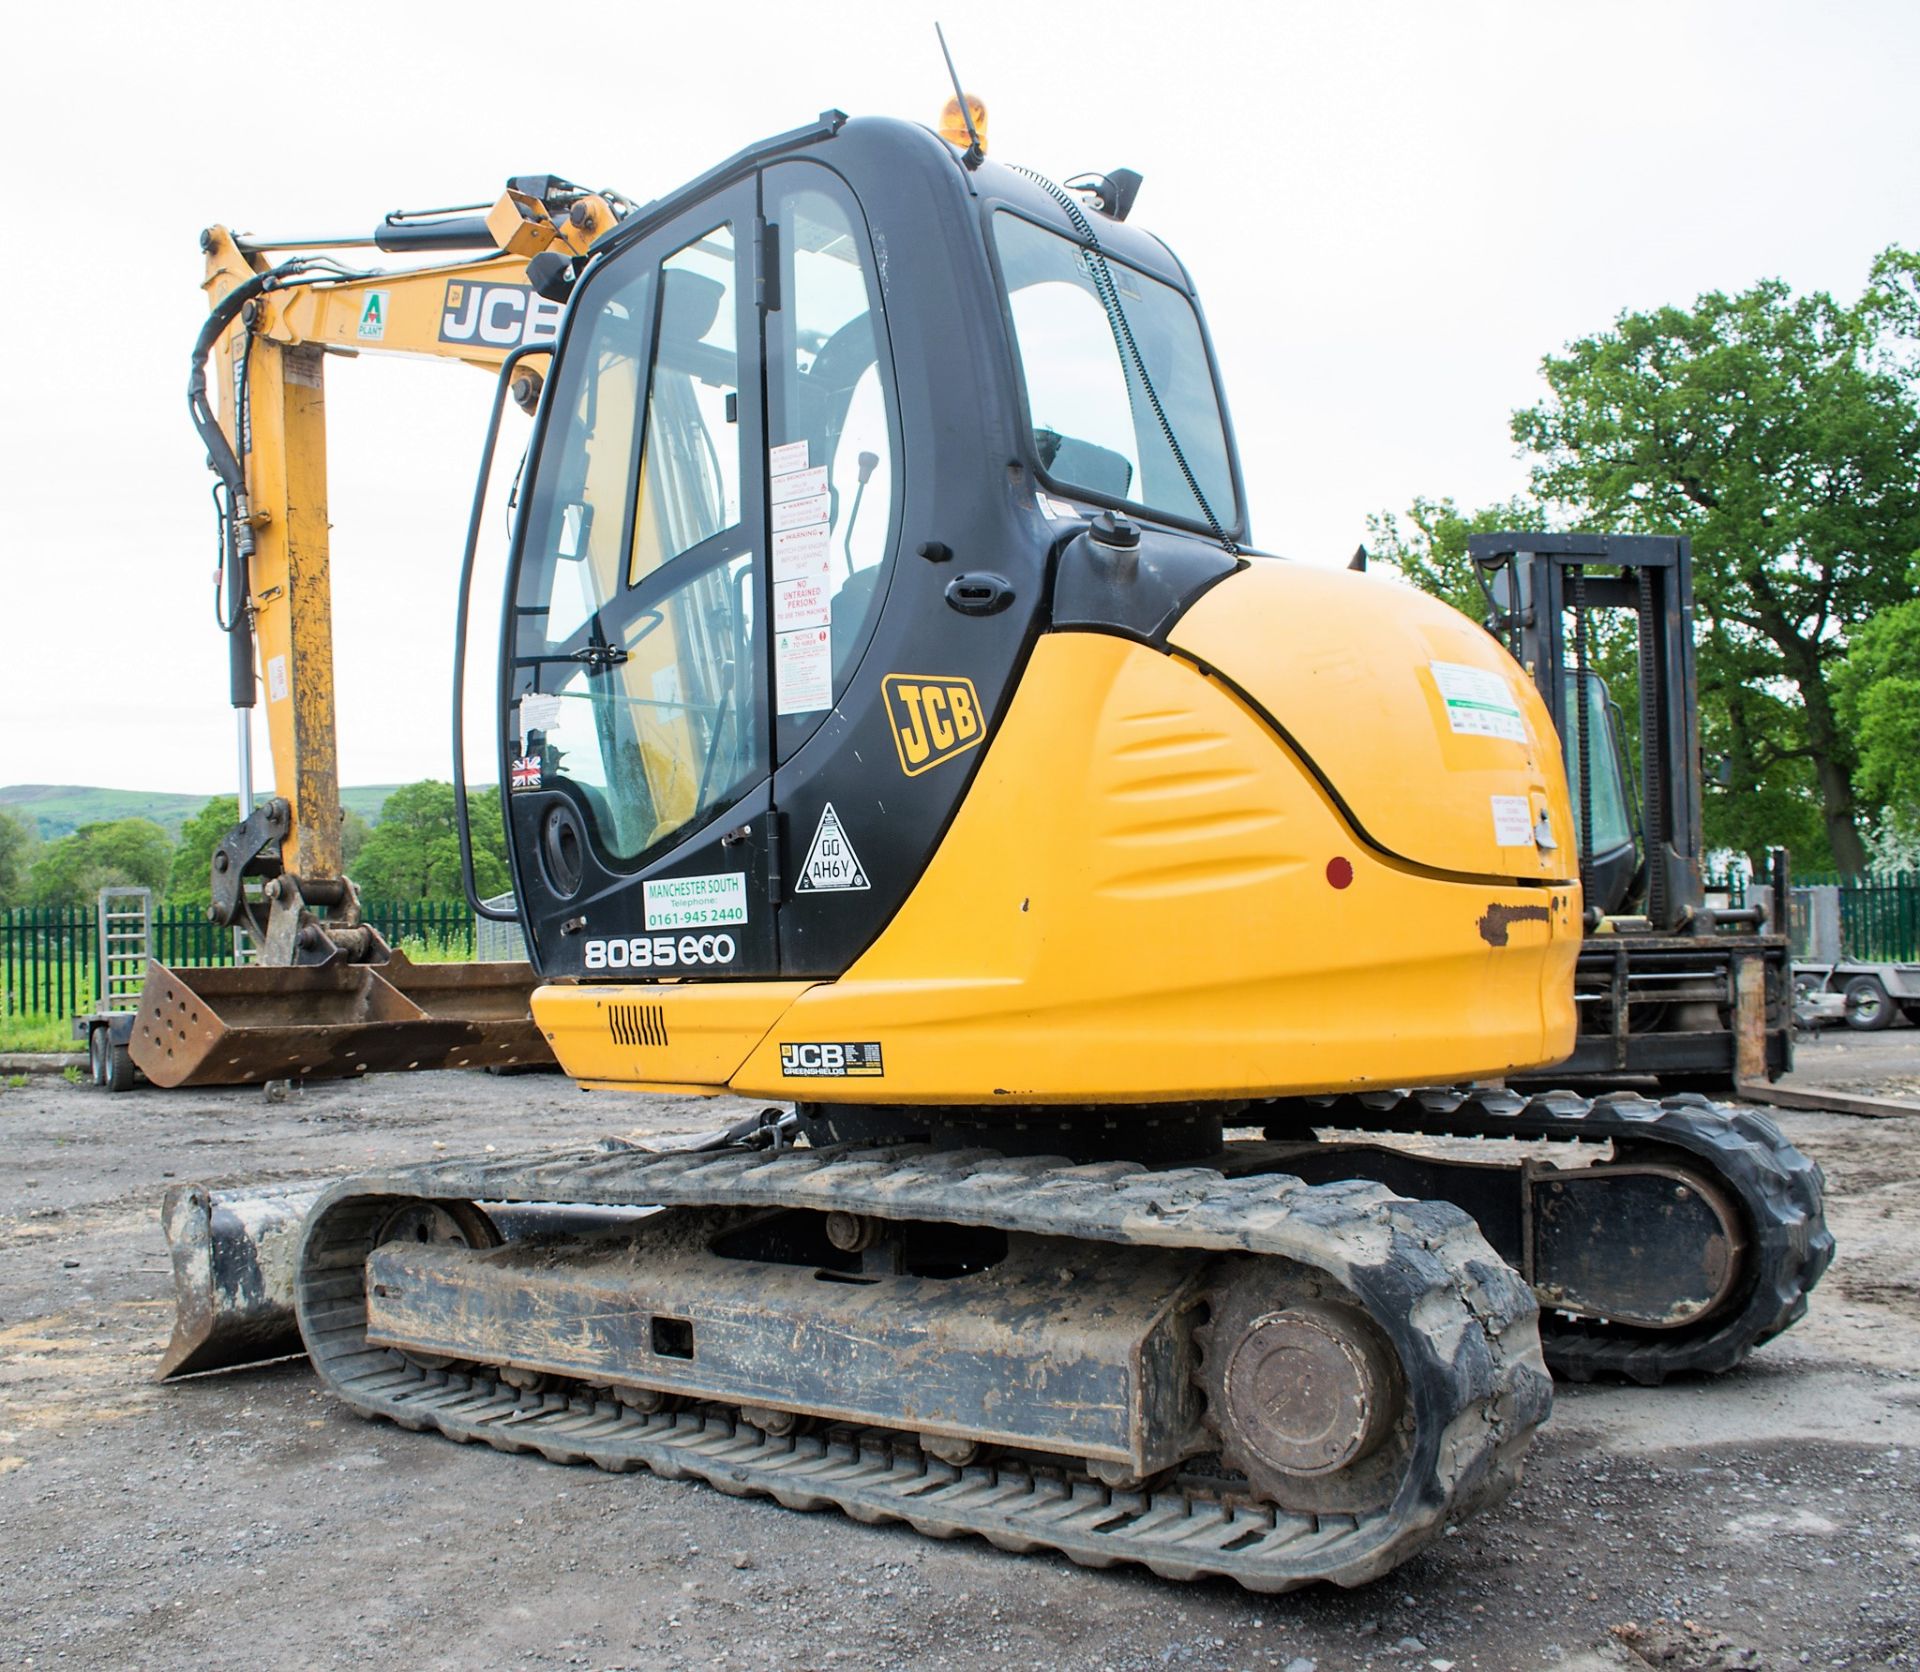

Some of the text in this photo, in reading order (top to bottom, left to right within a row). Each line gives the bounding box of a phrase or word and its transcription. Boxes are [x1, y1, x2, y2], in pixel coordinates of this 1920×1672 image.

[362, 294, 382, 324] A
[443, 286, 567, 345] JCB
[358, 325, 383, 336] PLANT
[788, 500, 813, 509] WARNING
[786, 529, 818, 541] WARNING
[797, 580, 806, 589] NO
[783, 587, 822, 601] UNTRAINED
[787, 597, 817, 609] PERSONS
[897, 684, 978, 764] JCB
[813, 859, 850, 879] AH6Y
[648, 877, 739, 899] MANCHESTER SOUTH
[670, 896, 718, 908] Telephone:
[649, 907, 743, 927] 0161-945 2440
[584, 933, 736, 969] 8085eco
[782, 1043, 845, 1068] JCB
[783, 1067, 845, 1076] GREENSHIELDS
